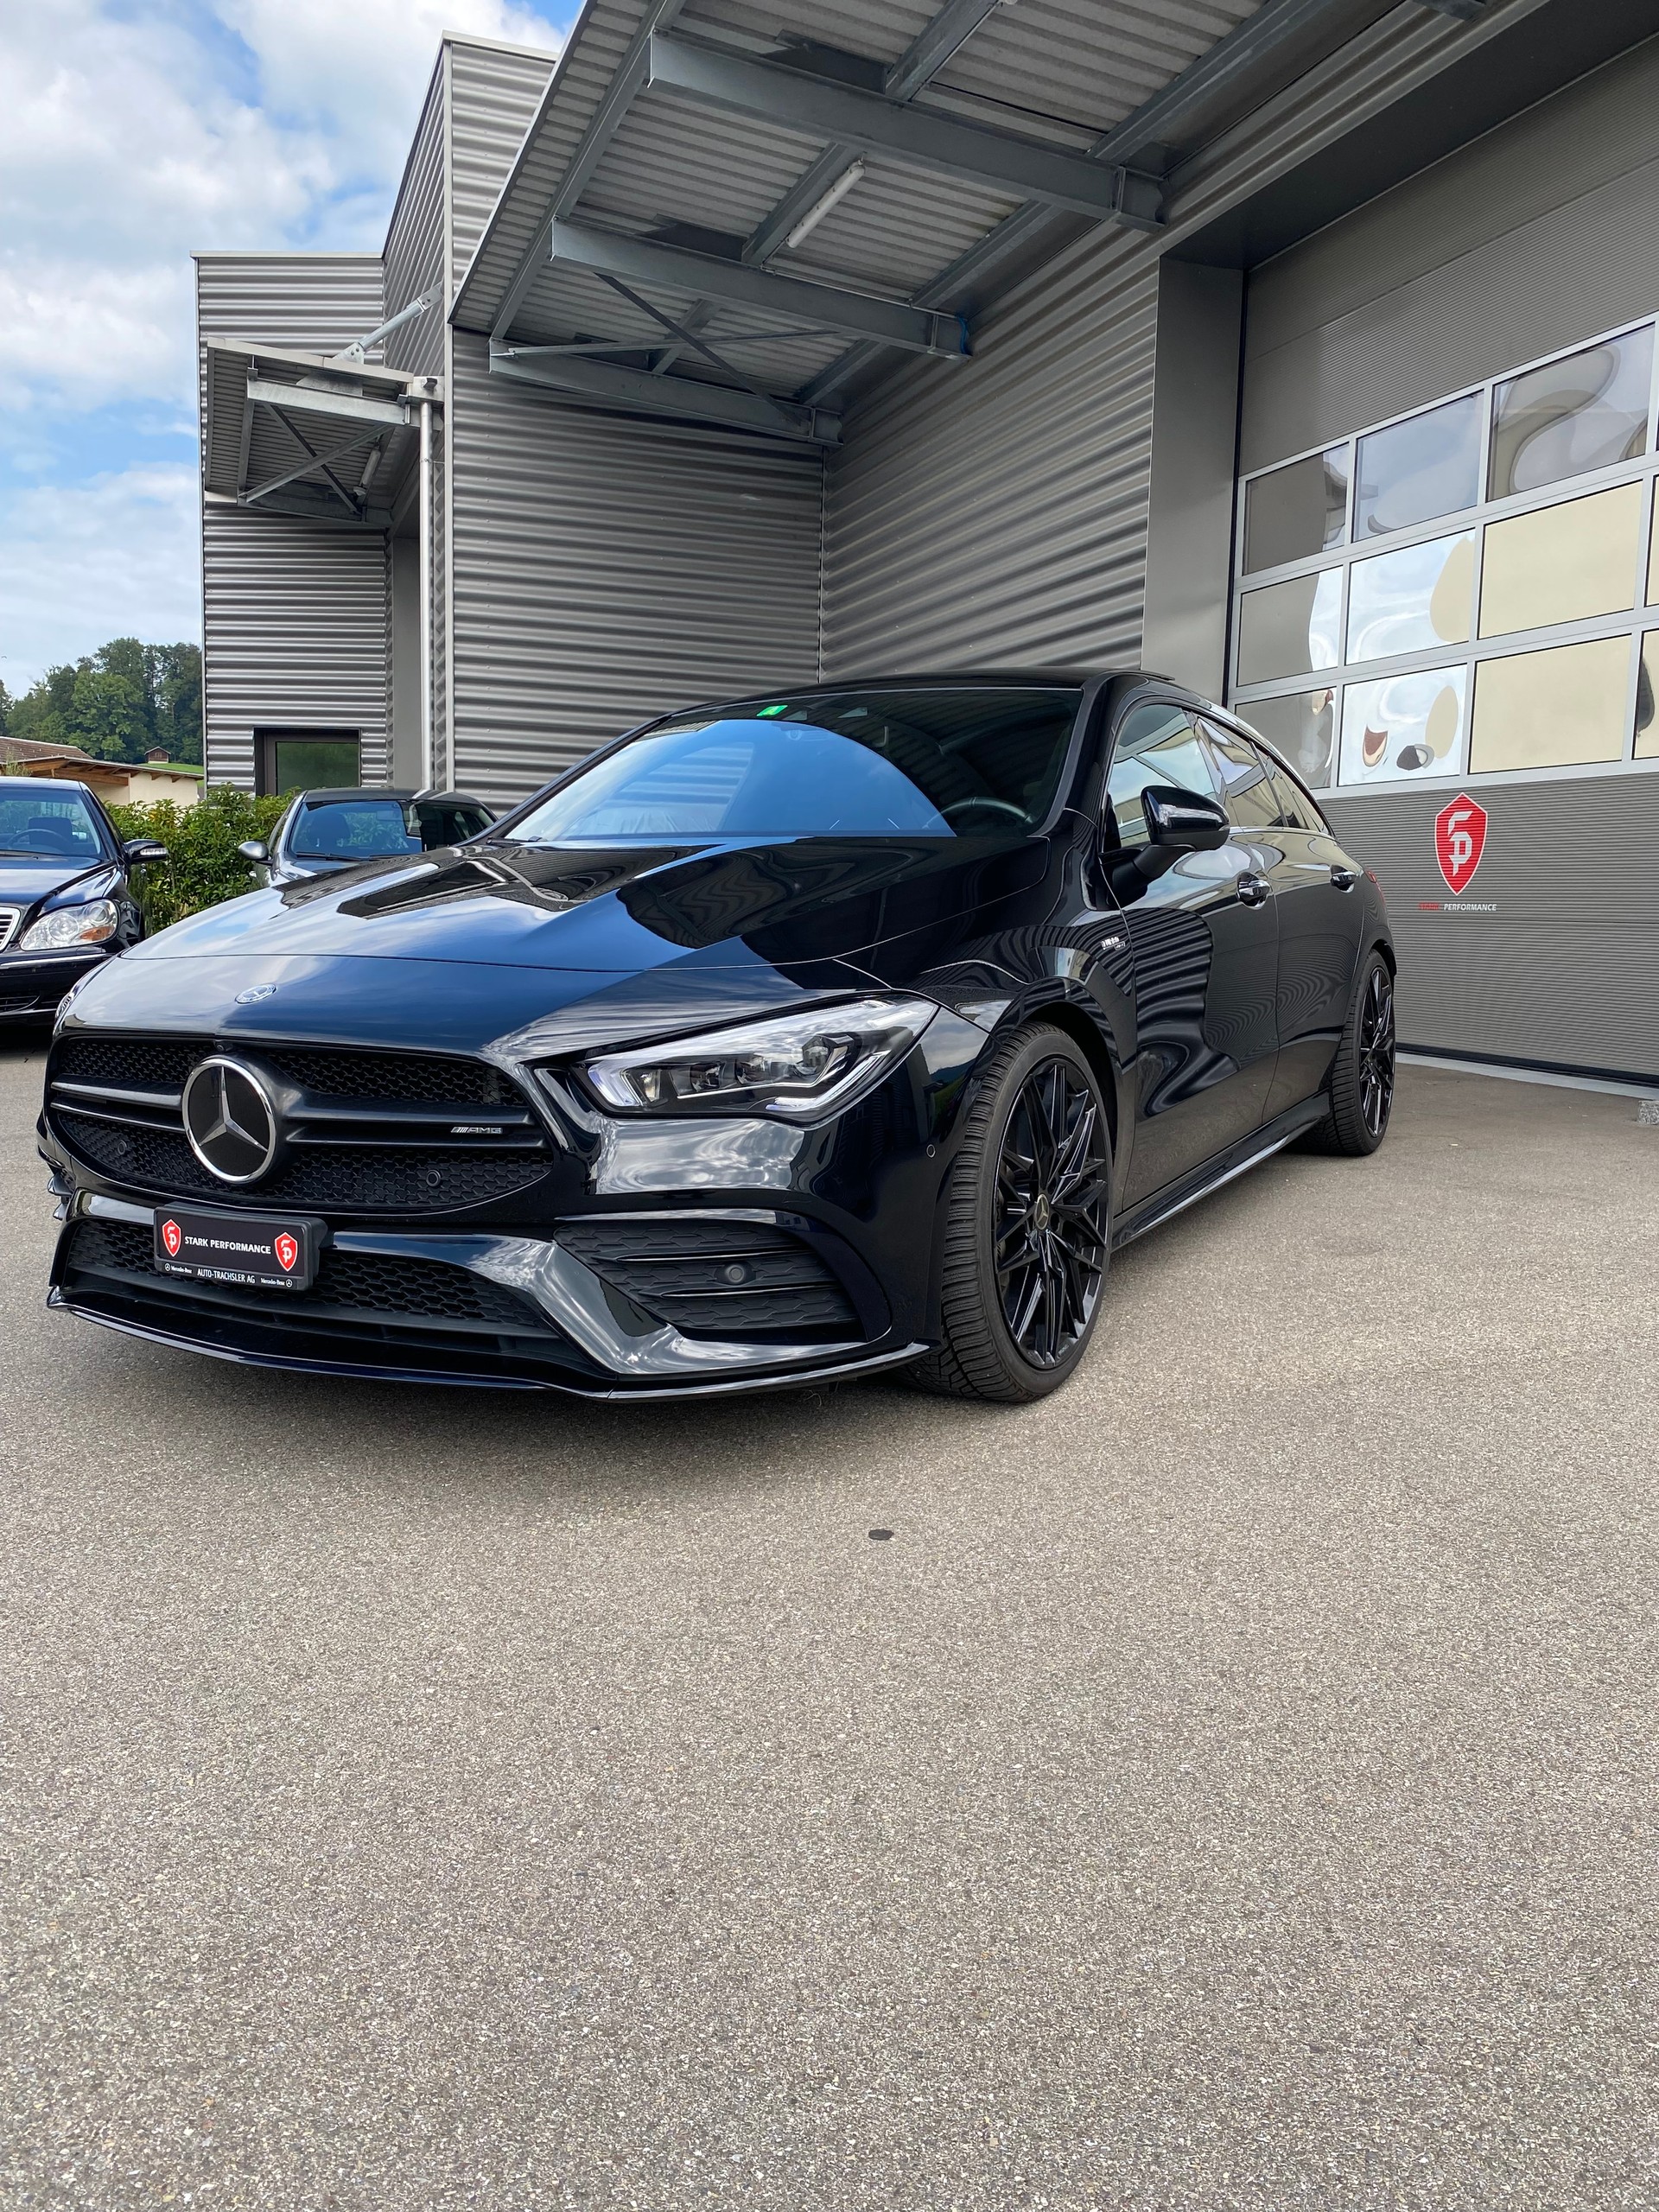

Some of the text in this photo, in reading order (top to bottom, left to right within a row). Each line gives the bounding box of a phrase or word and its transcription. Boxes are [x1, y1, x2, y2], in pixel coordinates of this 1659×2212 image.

[1444, 903, 1497, 912] PERFORMANCE
[184, 1236, 271, 1255] STARK PERFORMANCE
[197, 1268, 256, 1284] AUTO-TRACHSLER AG
